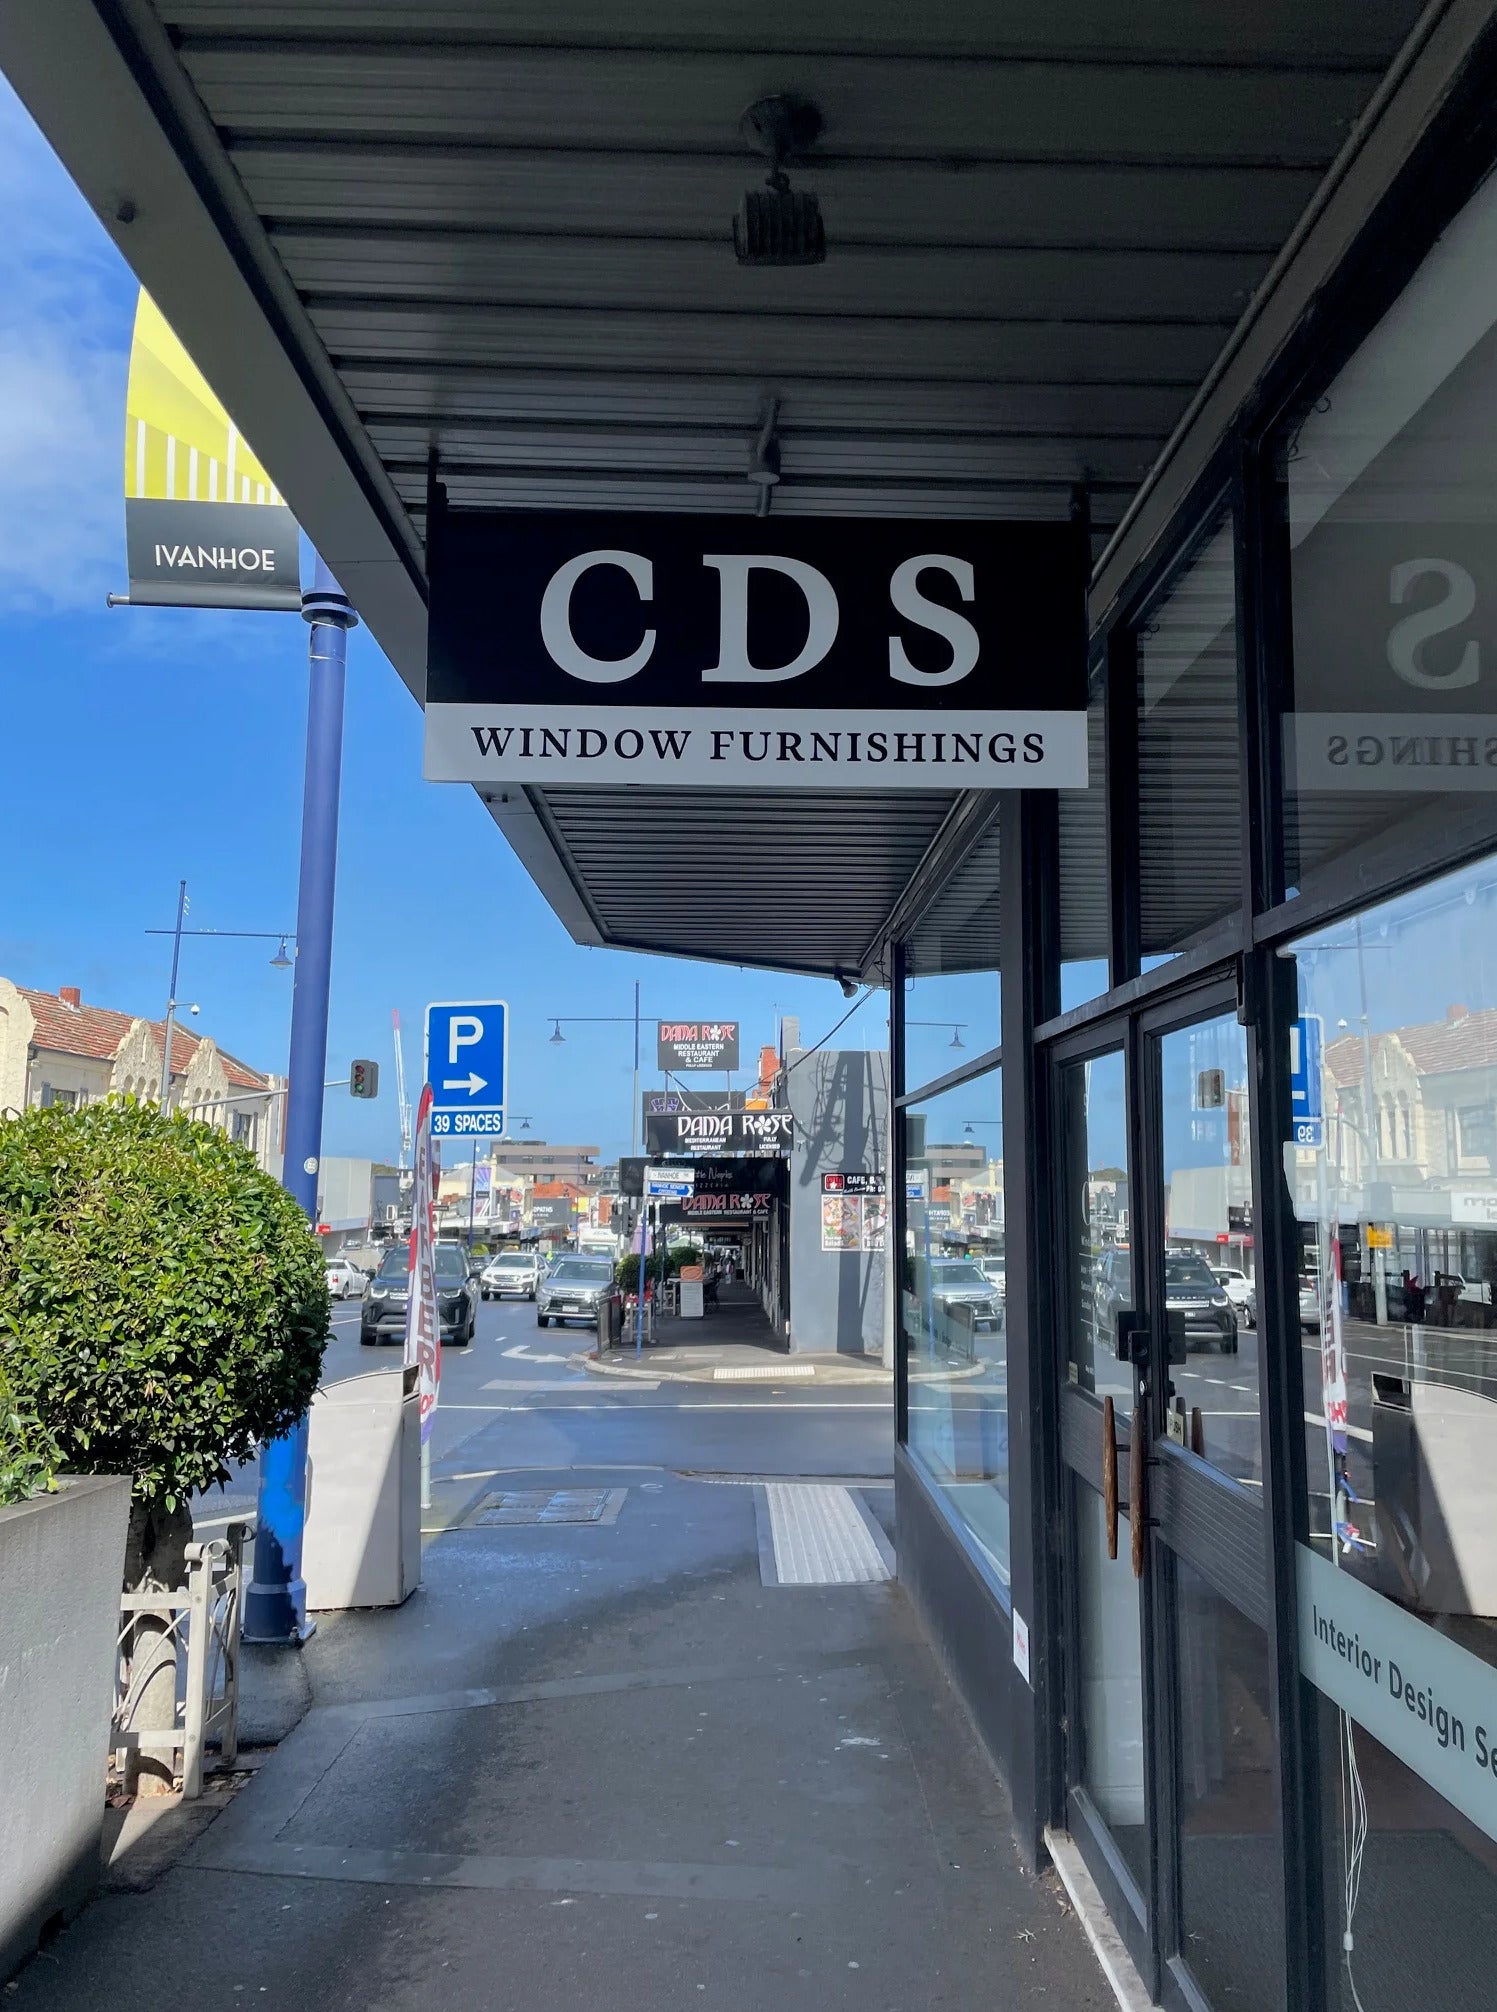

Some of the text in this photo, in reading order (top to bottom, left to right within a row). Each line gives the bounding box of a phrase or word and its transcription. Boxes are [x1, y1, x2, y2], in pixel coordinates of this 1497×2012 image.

[154, 544, 275, 571] IVANHOE
[471, 727, 1045, 764] WINDOW FURNISHINGS
[448, 1015, 484, 1064] P
[661, 1025, 698, 1041] DAMA
[434, 1113, 501, 1133] 39 SPACES
[677, 1115, 733, 1137] DAMA
[1312, 1604, 1381, 1684] Interior
[1388, 1660, 1466, 1752] Design
